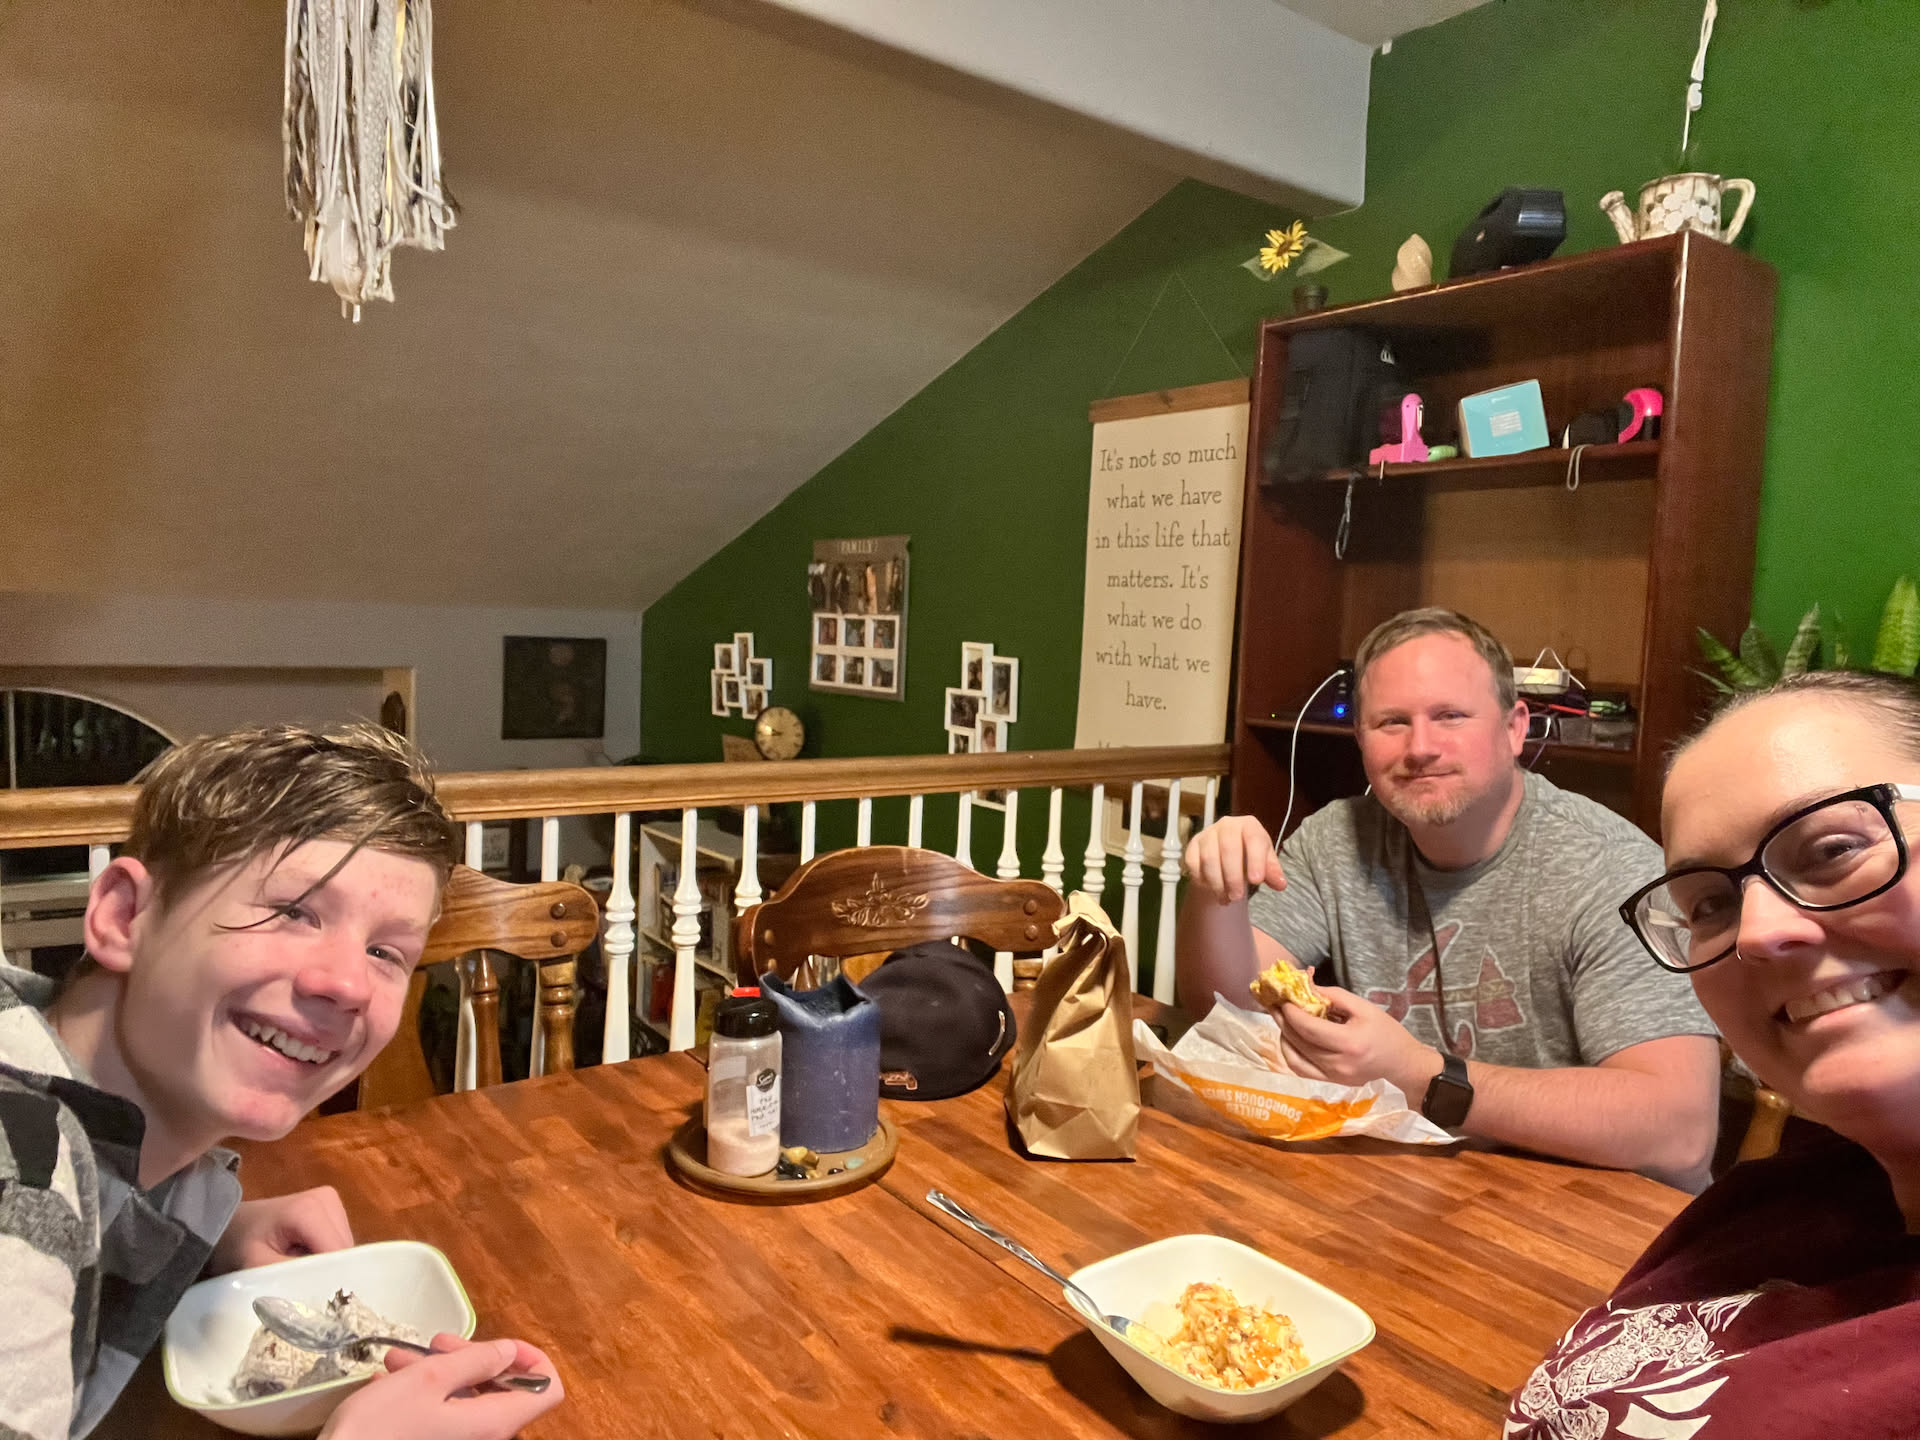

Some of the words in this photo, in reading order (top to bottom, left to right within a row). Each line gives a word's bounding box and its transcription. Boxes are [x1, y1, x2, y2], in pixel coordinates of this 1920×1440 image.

[1100, 449, 1124, 472] It's
[1129, 449, 1157, 469] not
[1162, 451, 1181, 466] so
[1188, 433, 1237, 464] much
[1107, 484, 1146, 509] what
[1152, 494, 1174, 507] we
[1180, 479, 1222, 506] have
[1096, 530, 1110, 549] in
[1117, 522, 1149, 549] this
[1155, 520, 1184, 548] life
[1192, 519, 1231, 547] that
[1106, 569, 1174, 589] matters.
[1180, 565, 1209, 589] It's
[1107, 601, 1147, 628] what
[1152, 615, 1174, 630] we
[1179, 602, 1202, 630] do
[1096, 640, 1132, 667] with
[1138, 642, 1179, 671] what
[1186, 656, 1210, 673] we
[1125, 680, 1167, 710] have.
[1234, 1090, 1303, 1122] SOURDOUGH
